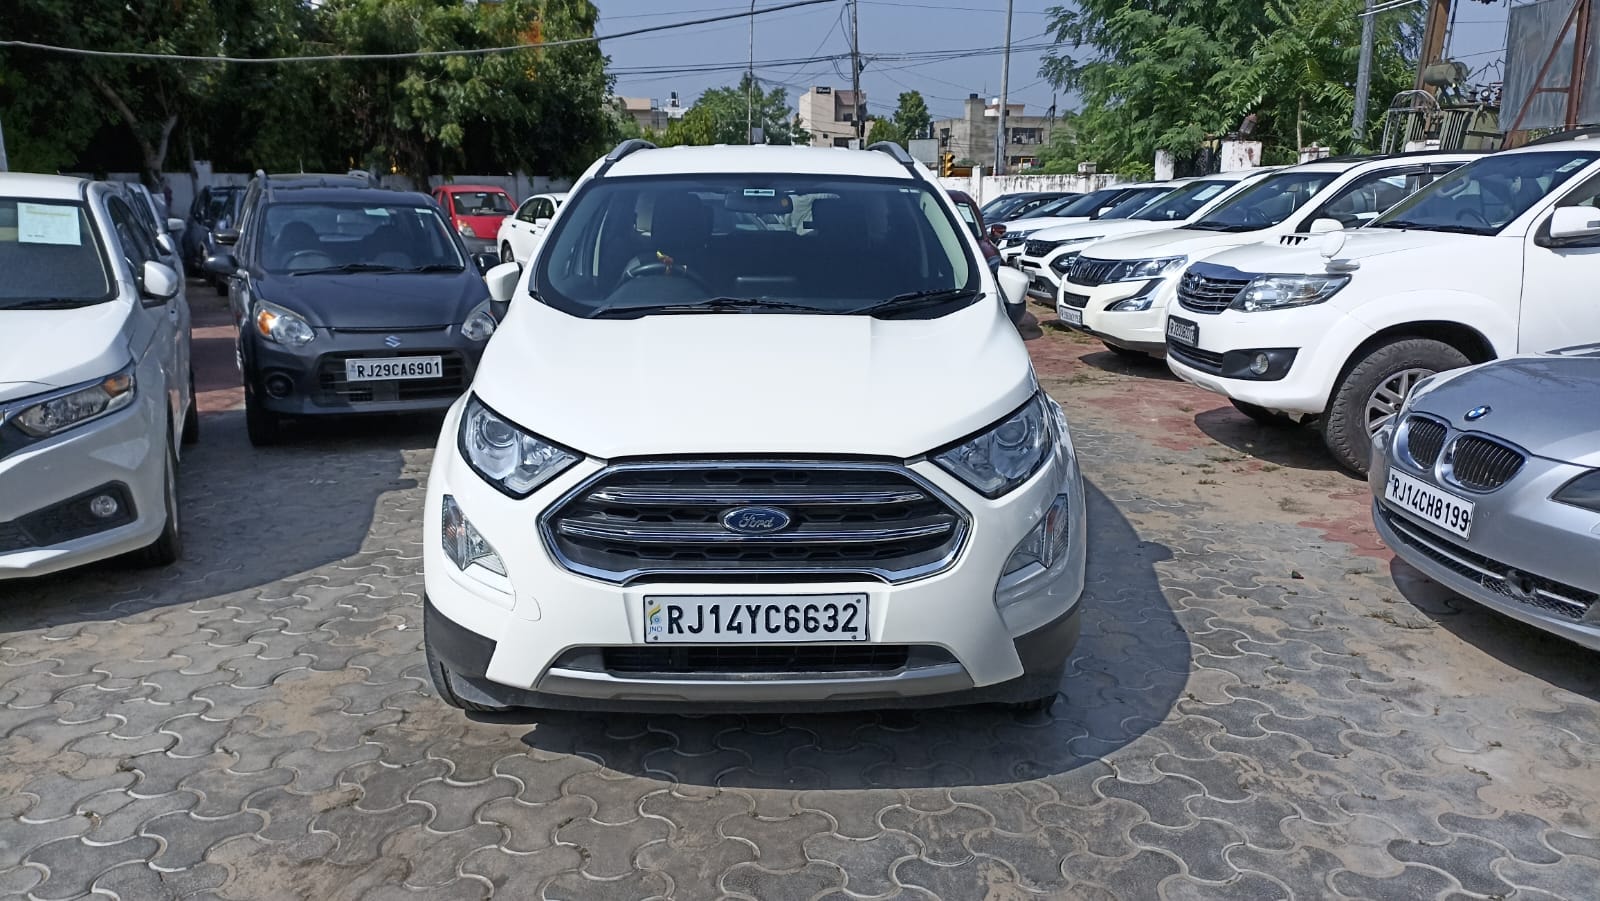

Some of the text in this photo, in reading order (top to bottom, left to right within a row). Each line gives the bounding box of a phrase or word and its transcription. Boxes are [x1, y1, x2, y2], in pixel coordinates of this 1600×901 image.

[357, 361, 440, 378] RJ29CA6901
[1392, 478, 1469, 531] RJ14CH8199
[738, 512, 774, 528] Ford
[667, 604, 859, 634] RJ14YC6632
